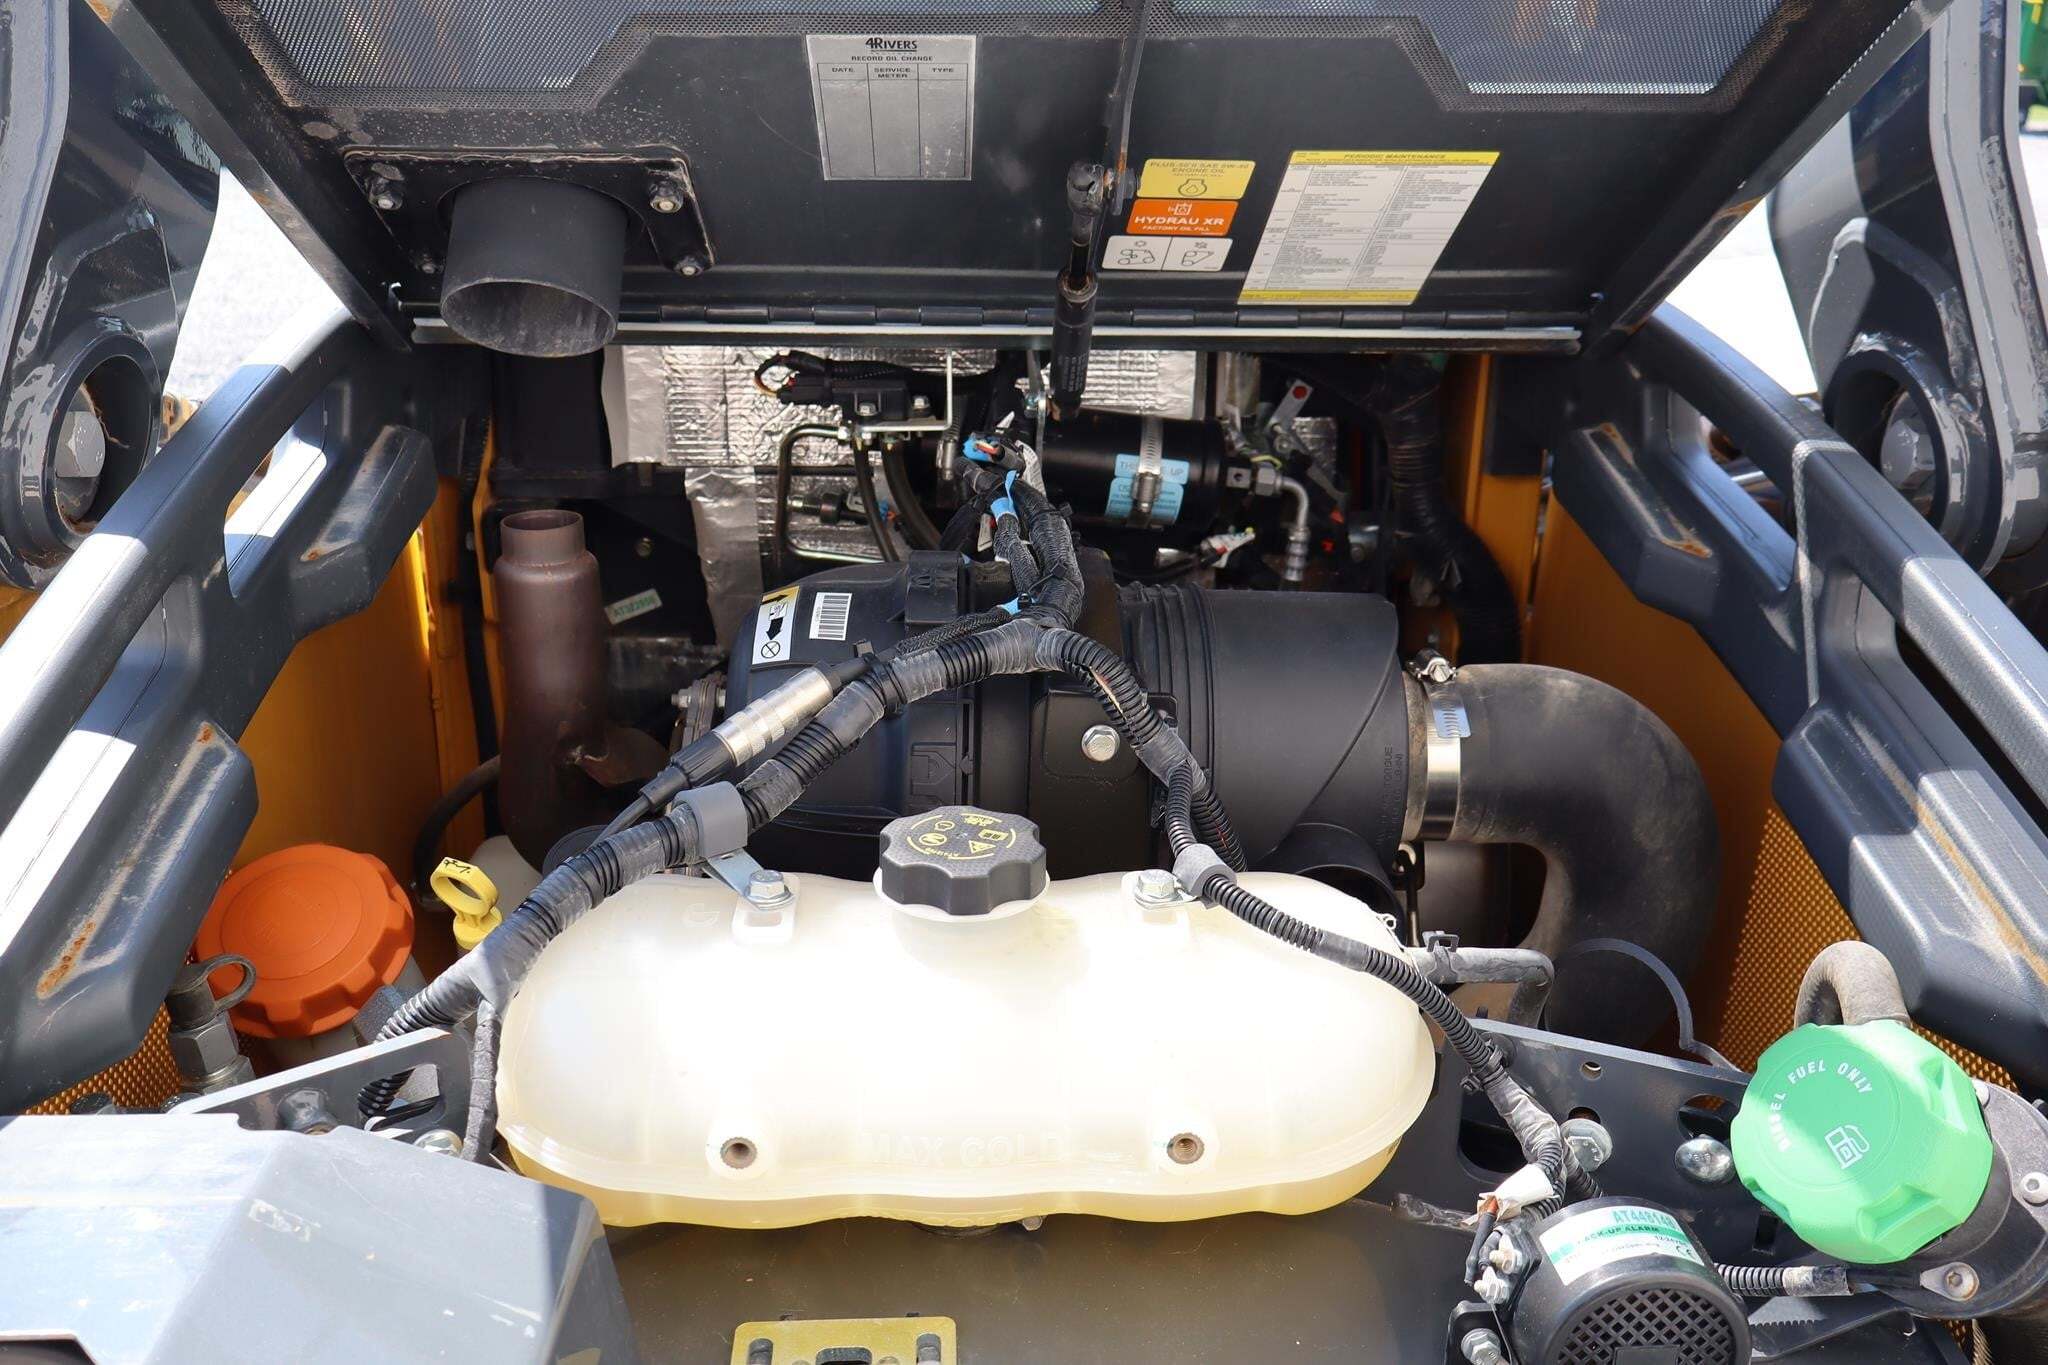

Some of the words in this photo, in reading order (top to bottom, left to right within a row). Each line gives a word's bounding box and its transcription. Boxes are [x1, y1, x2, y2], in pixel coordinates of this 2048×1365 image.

[865, 38, 918, 50] 4RIVERS
[1134, 216, 1200, 225] HYDRAU
[1203, 217, 1225, 225] XR
[1787, 1059, 1827, 1085] FUEL
[1836, 1062, 1873, 1094] ONLY
[1577, 1226, 1622, 1245] ACK-UP
